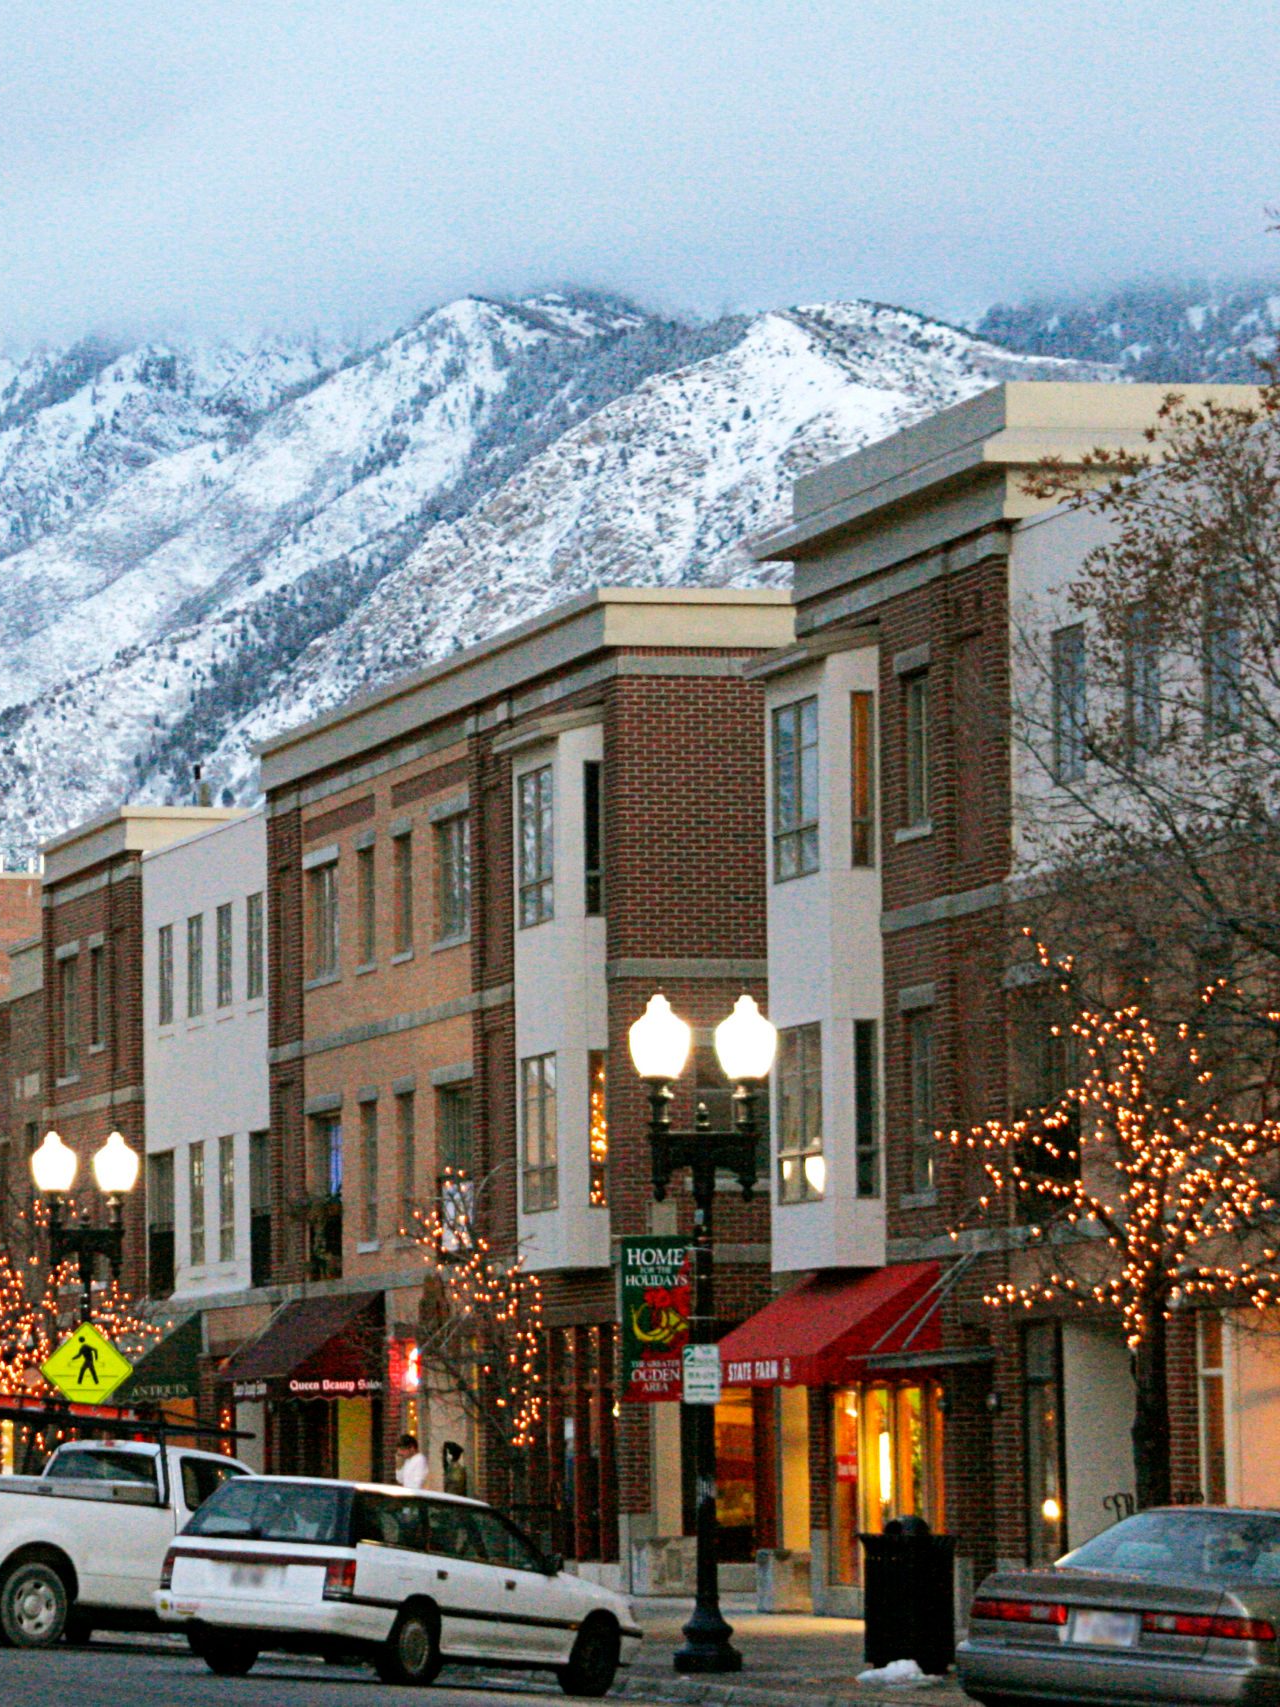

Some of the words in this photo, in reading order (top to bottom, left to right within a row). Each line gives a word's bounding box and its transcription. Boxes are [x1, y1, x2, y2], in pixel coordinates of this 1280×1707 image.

[626, 1247, 685, 1266] HOME
[625, 1274, 688, 1287] HOLIDAYS
[631, 1367, 681, 1382] OGDEN
[728, 1361, 752, 1382] STATE
[754, 1359, 778, 1380] FARM
[289, 1379, 320, 1392] Queen
[322, 1379, 356, 1392] Beauty
[642, 1382, 668, 1392] AREA
